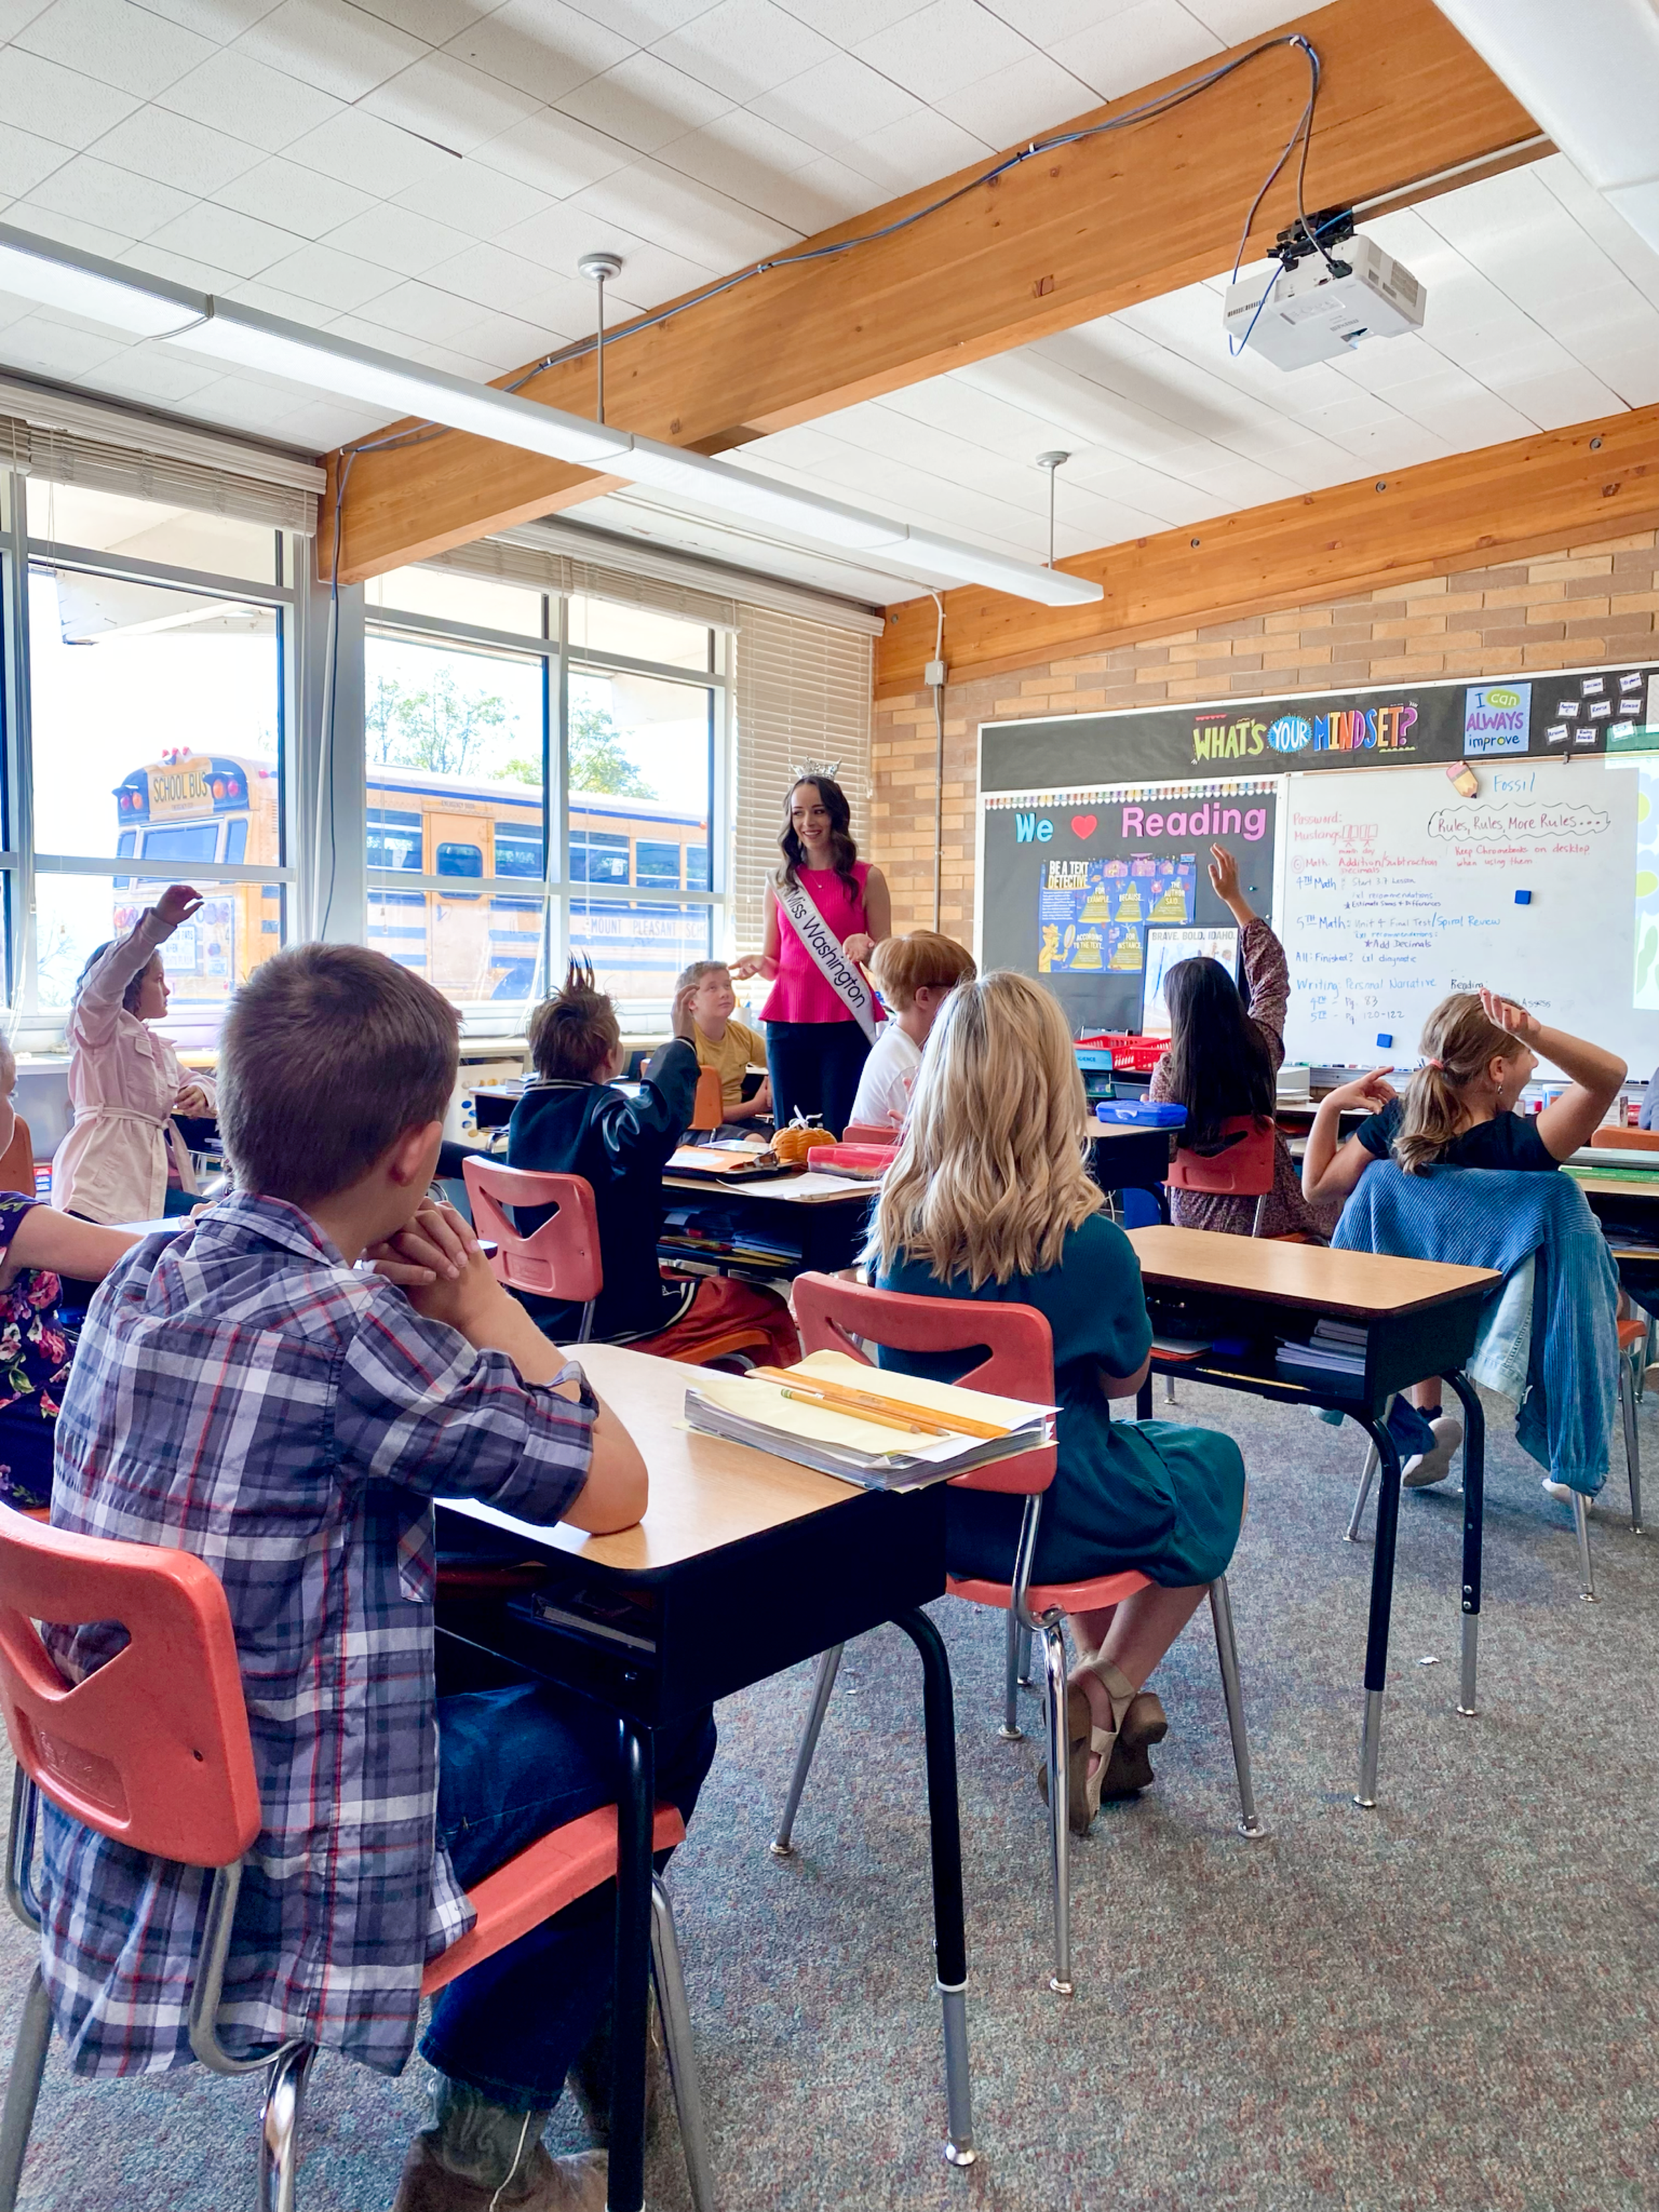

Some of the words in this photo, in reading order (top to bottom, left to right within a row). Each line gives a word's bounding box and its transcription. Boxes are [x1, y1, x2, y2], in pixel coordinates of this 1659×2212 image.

[1475, 693, 1485, 709] I
[1491, 693, 1517, 706] can
[1467, 711, 1524, 731] ALWAYS
[1193, 719, 1267, 761] WHAT'S
[1273, 720, 1309, 750] YOUR
[1314, 705, 1418, 752] MINDSET?
[1469, 734, 1520, 751] improve
[153, 774, 186, 802] SCHOOL
[189, 772, 208, 798] BUS
[1494, 772, 1536, 792] Fossil
[1015, 812, 1054, 843] We
[1121, 802, 1267, 842] Reading
[1293, 811, 1342, 825] Password:
[1438, 818, 1471, 835] Rules,
[1474, 816, 1505, 833] Rules,
[1508, 817, 1536, 830] More
[1455, 846, 1473, 857] Keep
[1476, 845, 1528, 855] Chromebooks
[1049, 861, 1060, 875] BE
[1062, 861, 1067, 875] A
[1069, 861, 1089, 875] TEXT
[1457, 857, 1477, 866] when
[1484, 858, 1506, 868] using
[1048, 875, 1088, 888] DETECTIVE
[591, 918, 621, 934] MOUNT
[632, 920, 676, 936] PLEASANT
[1355, 919, 1374, 928] Unit
[1390, 918, 1409, 927] Final
[1468, 915, 1500, 926] Review
[1076, 933, 1103, 942] ACCORDING
[1152, 931, 1180, 940] BRAVE.
[1183, 930, 1205, 940] BOLD.
[1208, 930, 1236, 940] IDAHO.
[786, 890, 808, 919] Miss
[802, 916, 865, 1008] Washington
[1394, 940, 1432, 948] Decimals
[1379, 954, 1417, 967] diagnostic
[1346, 978, 1383, 990] Personal
[1390, 978, 1437, 989] Narrative
[1365, 996, 1378, 1007] 83
[1364, 1011, 1405, 1019] 120-122
